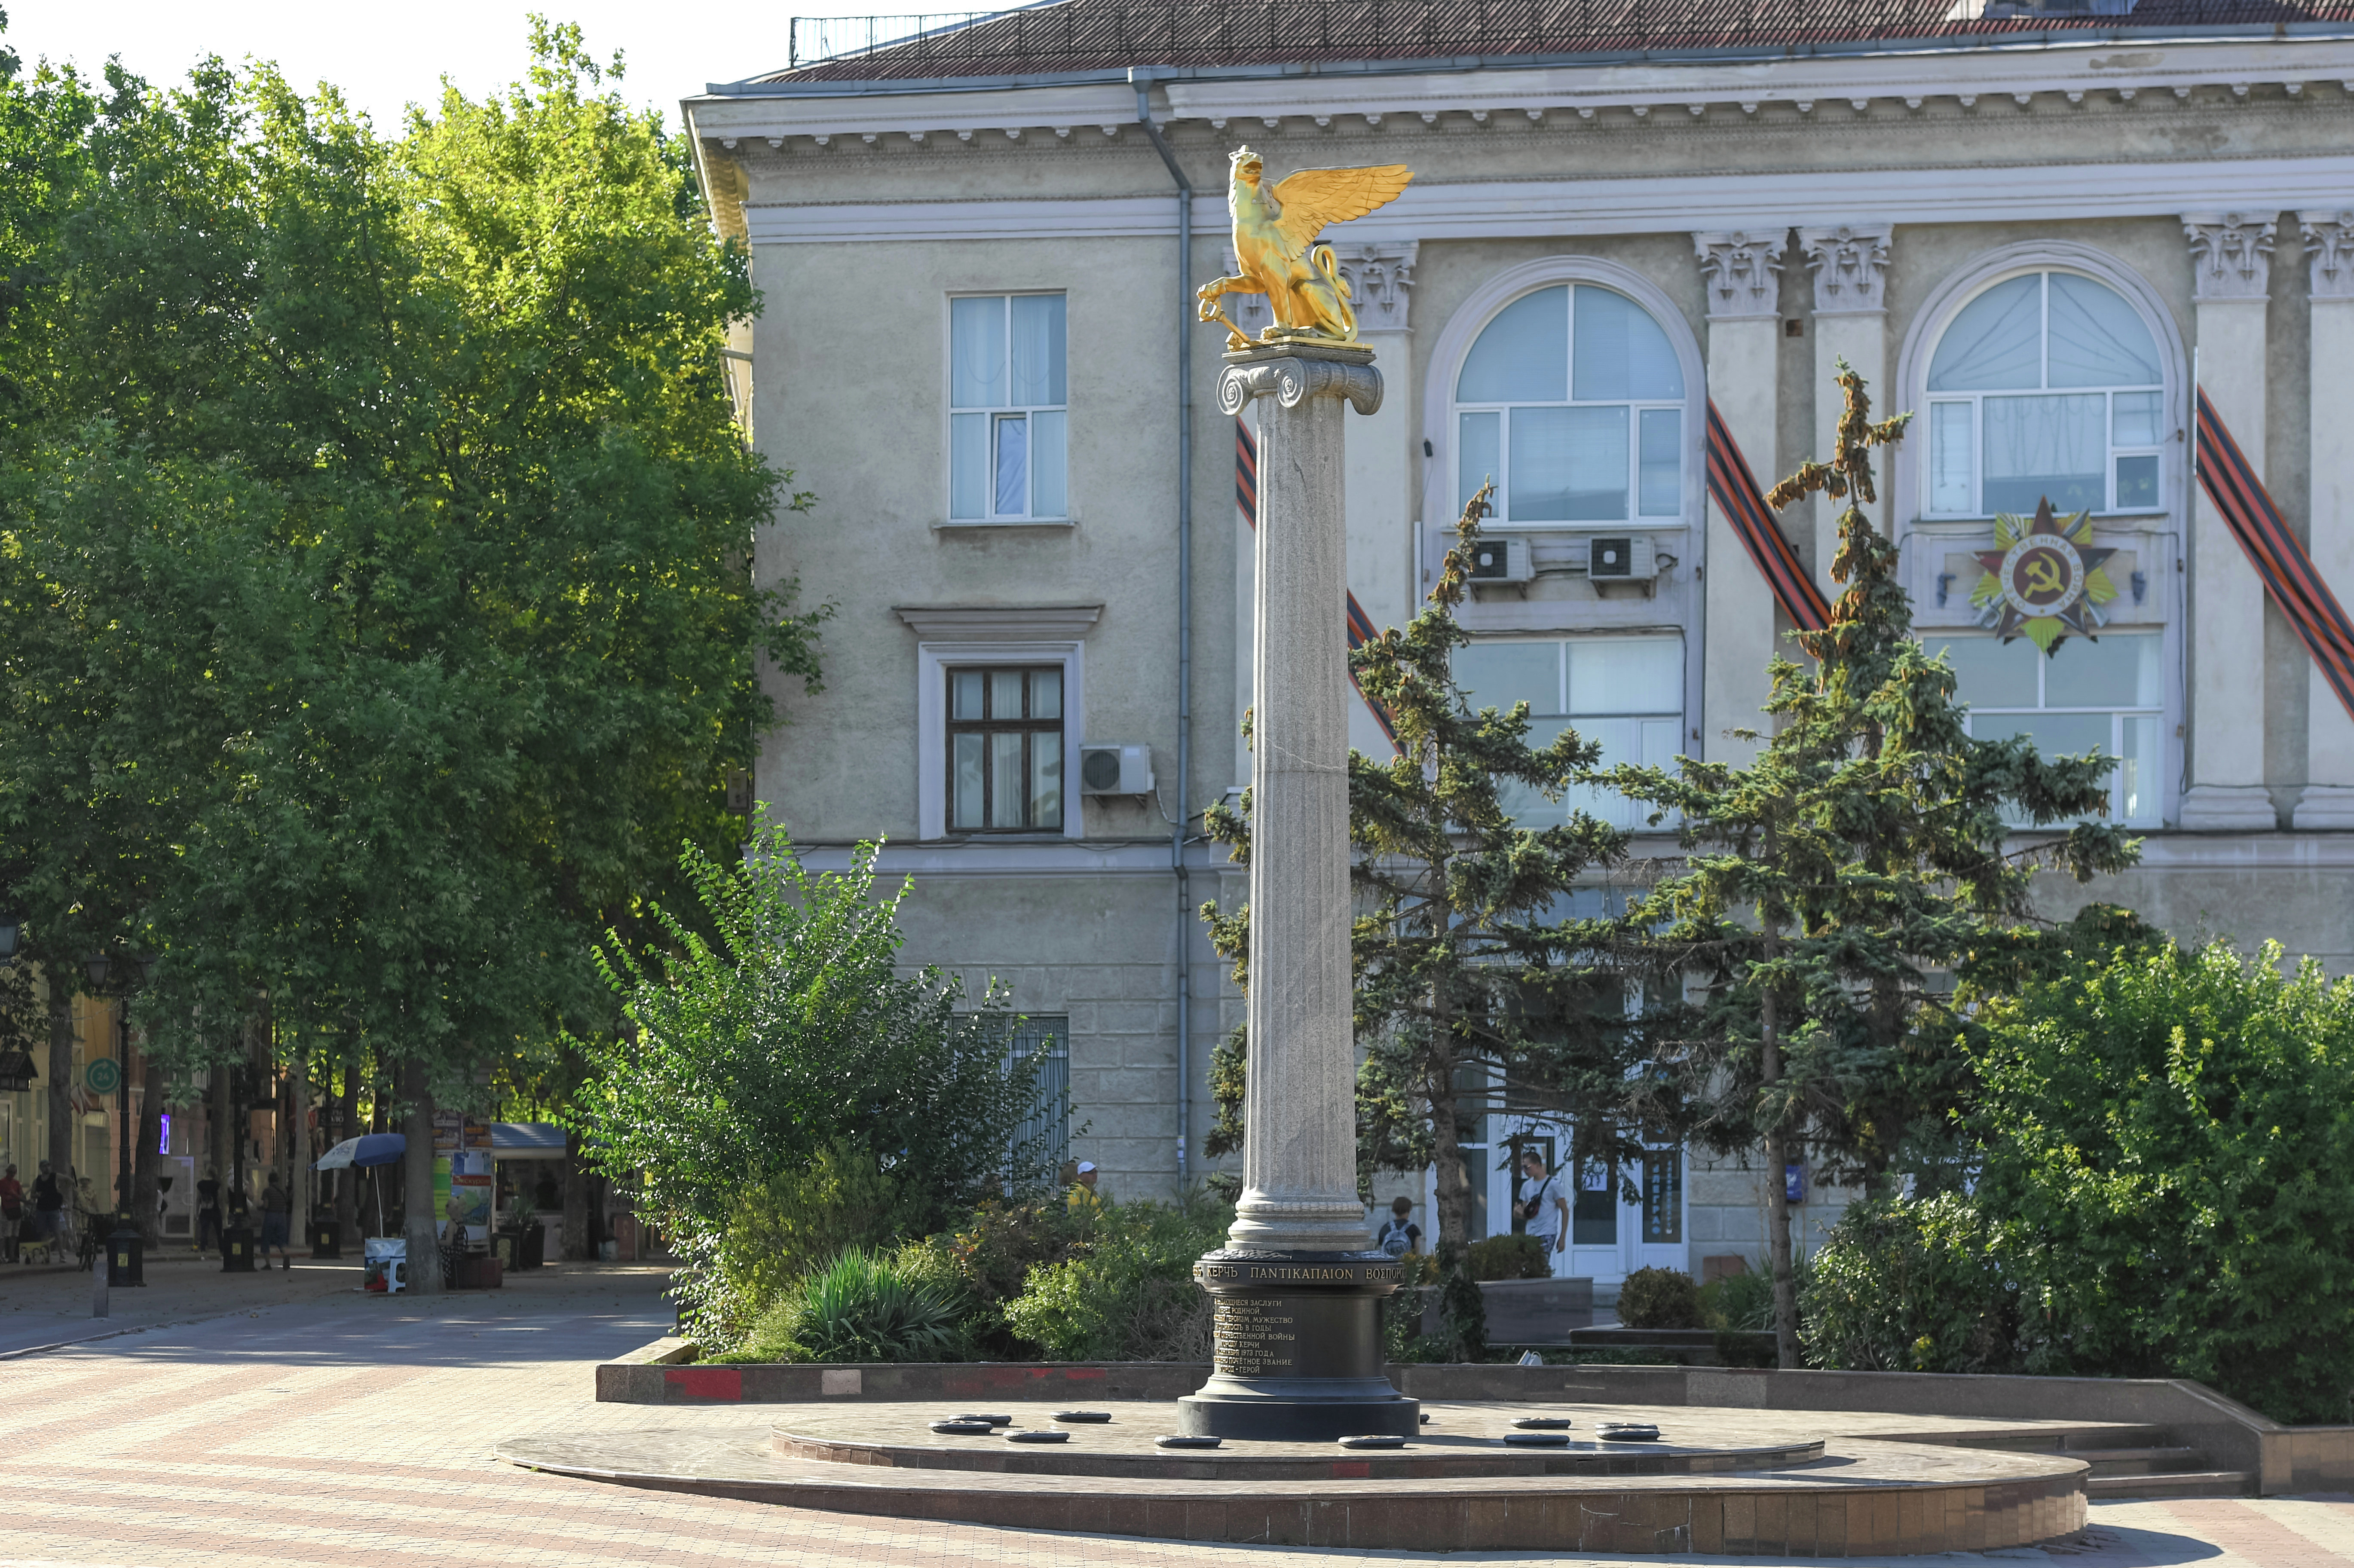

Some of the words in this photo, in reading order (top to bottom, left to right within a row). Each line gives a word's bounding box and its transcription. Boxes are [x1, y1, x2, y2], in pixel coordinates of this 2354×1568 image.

[2003, 538, 2076, 609] ОТЕЧЕСТВЕННАЯ
[2057, 564, 2083, 608] ВОЙНА
[97, 1073, 109, 1081] 24
[1207, 1265, 1238, 1277] КЕРЧЬ
